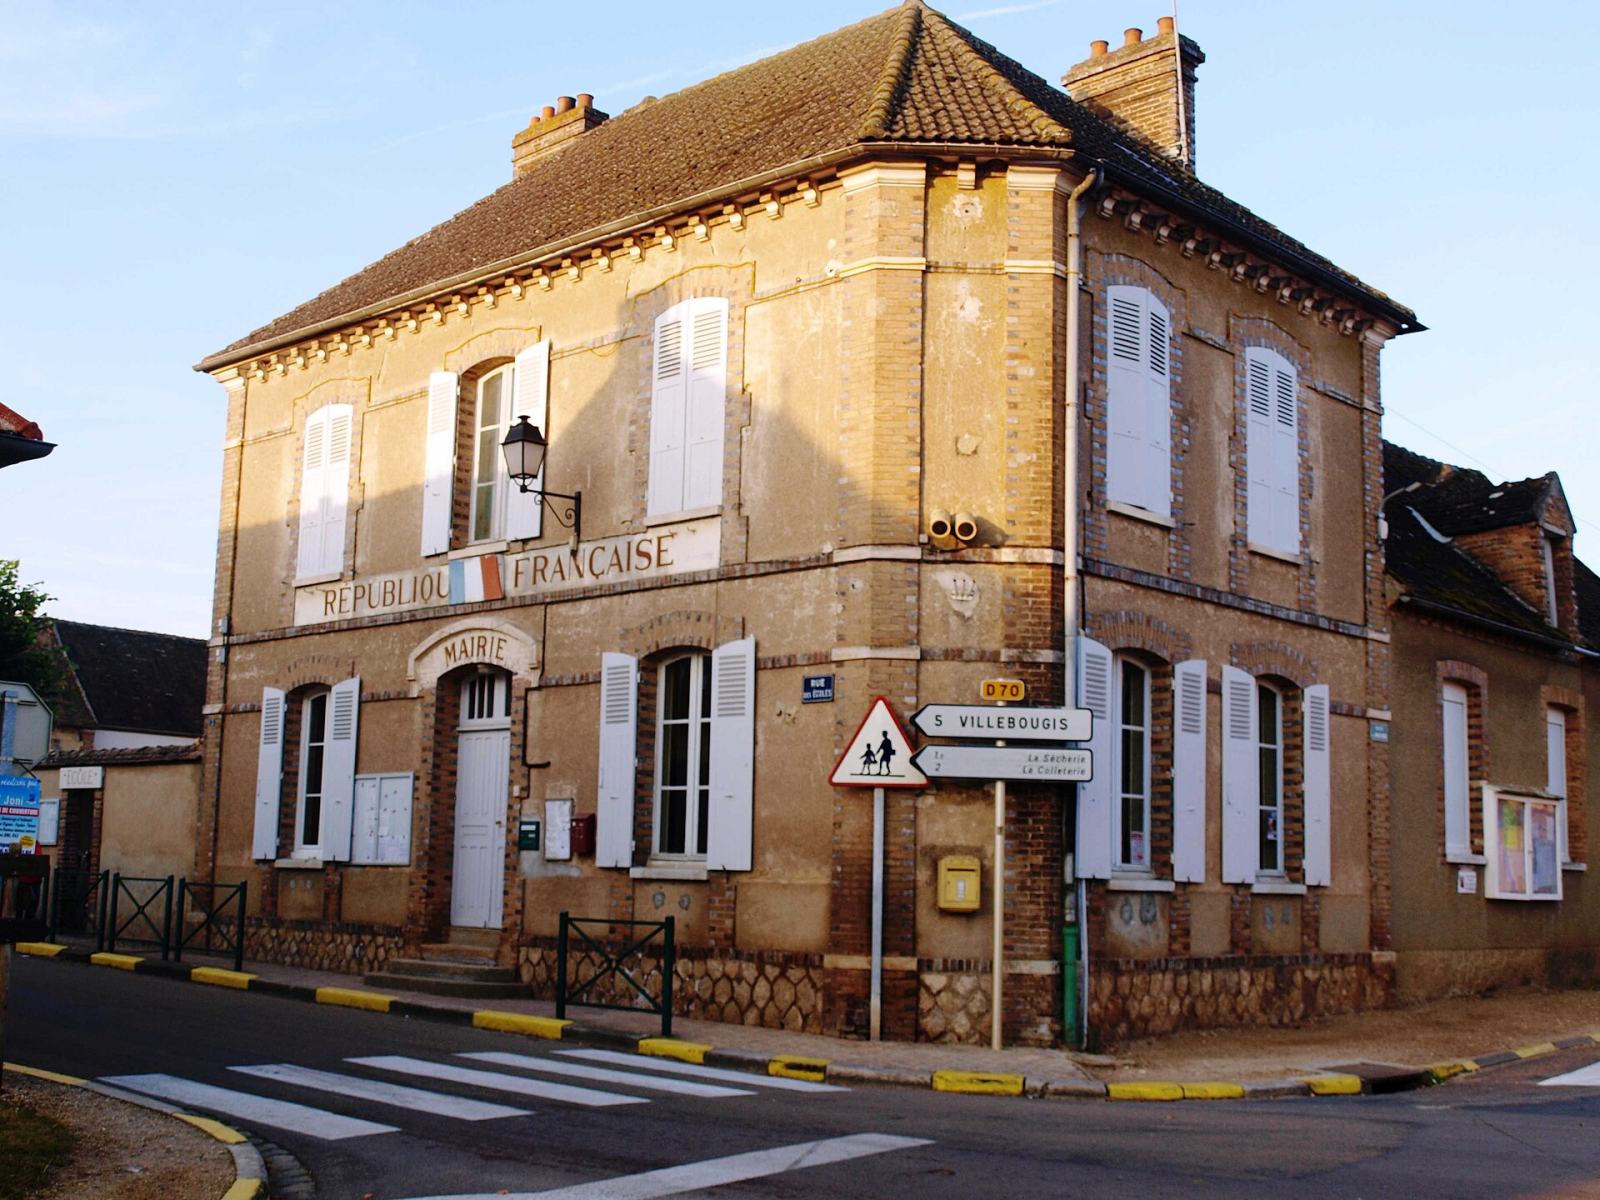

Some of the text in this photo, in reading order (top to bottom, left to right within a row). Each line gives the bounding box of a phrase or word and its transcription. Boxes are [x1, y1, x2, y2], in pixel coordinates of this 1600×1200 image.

[323, 534, 674, 616] RÉPUBLIQU FRANÇAISE
[445, 635, 508, 665] MAIRIE
[810, 678, 825, 688] RUE
[986, 684, 1020, 697] D 70
[934, 714, 1069, 730] 5 VILLEBOUGIS
[1028, 754, 1039, 762] La
[1022, 766, 1033, 775] La
